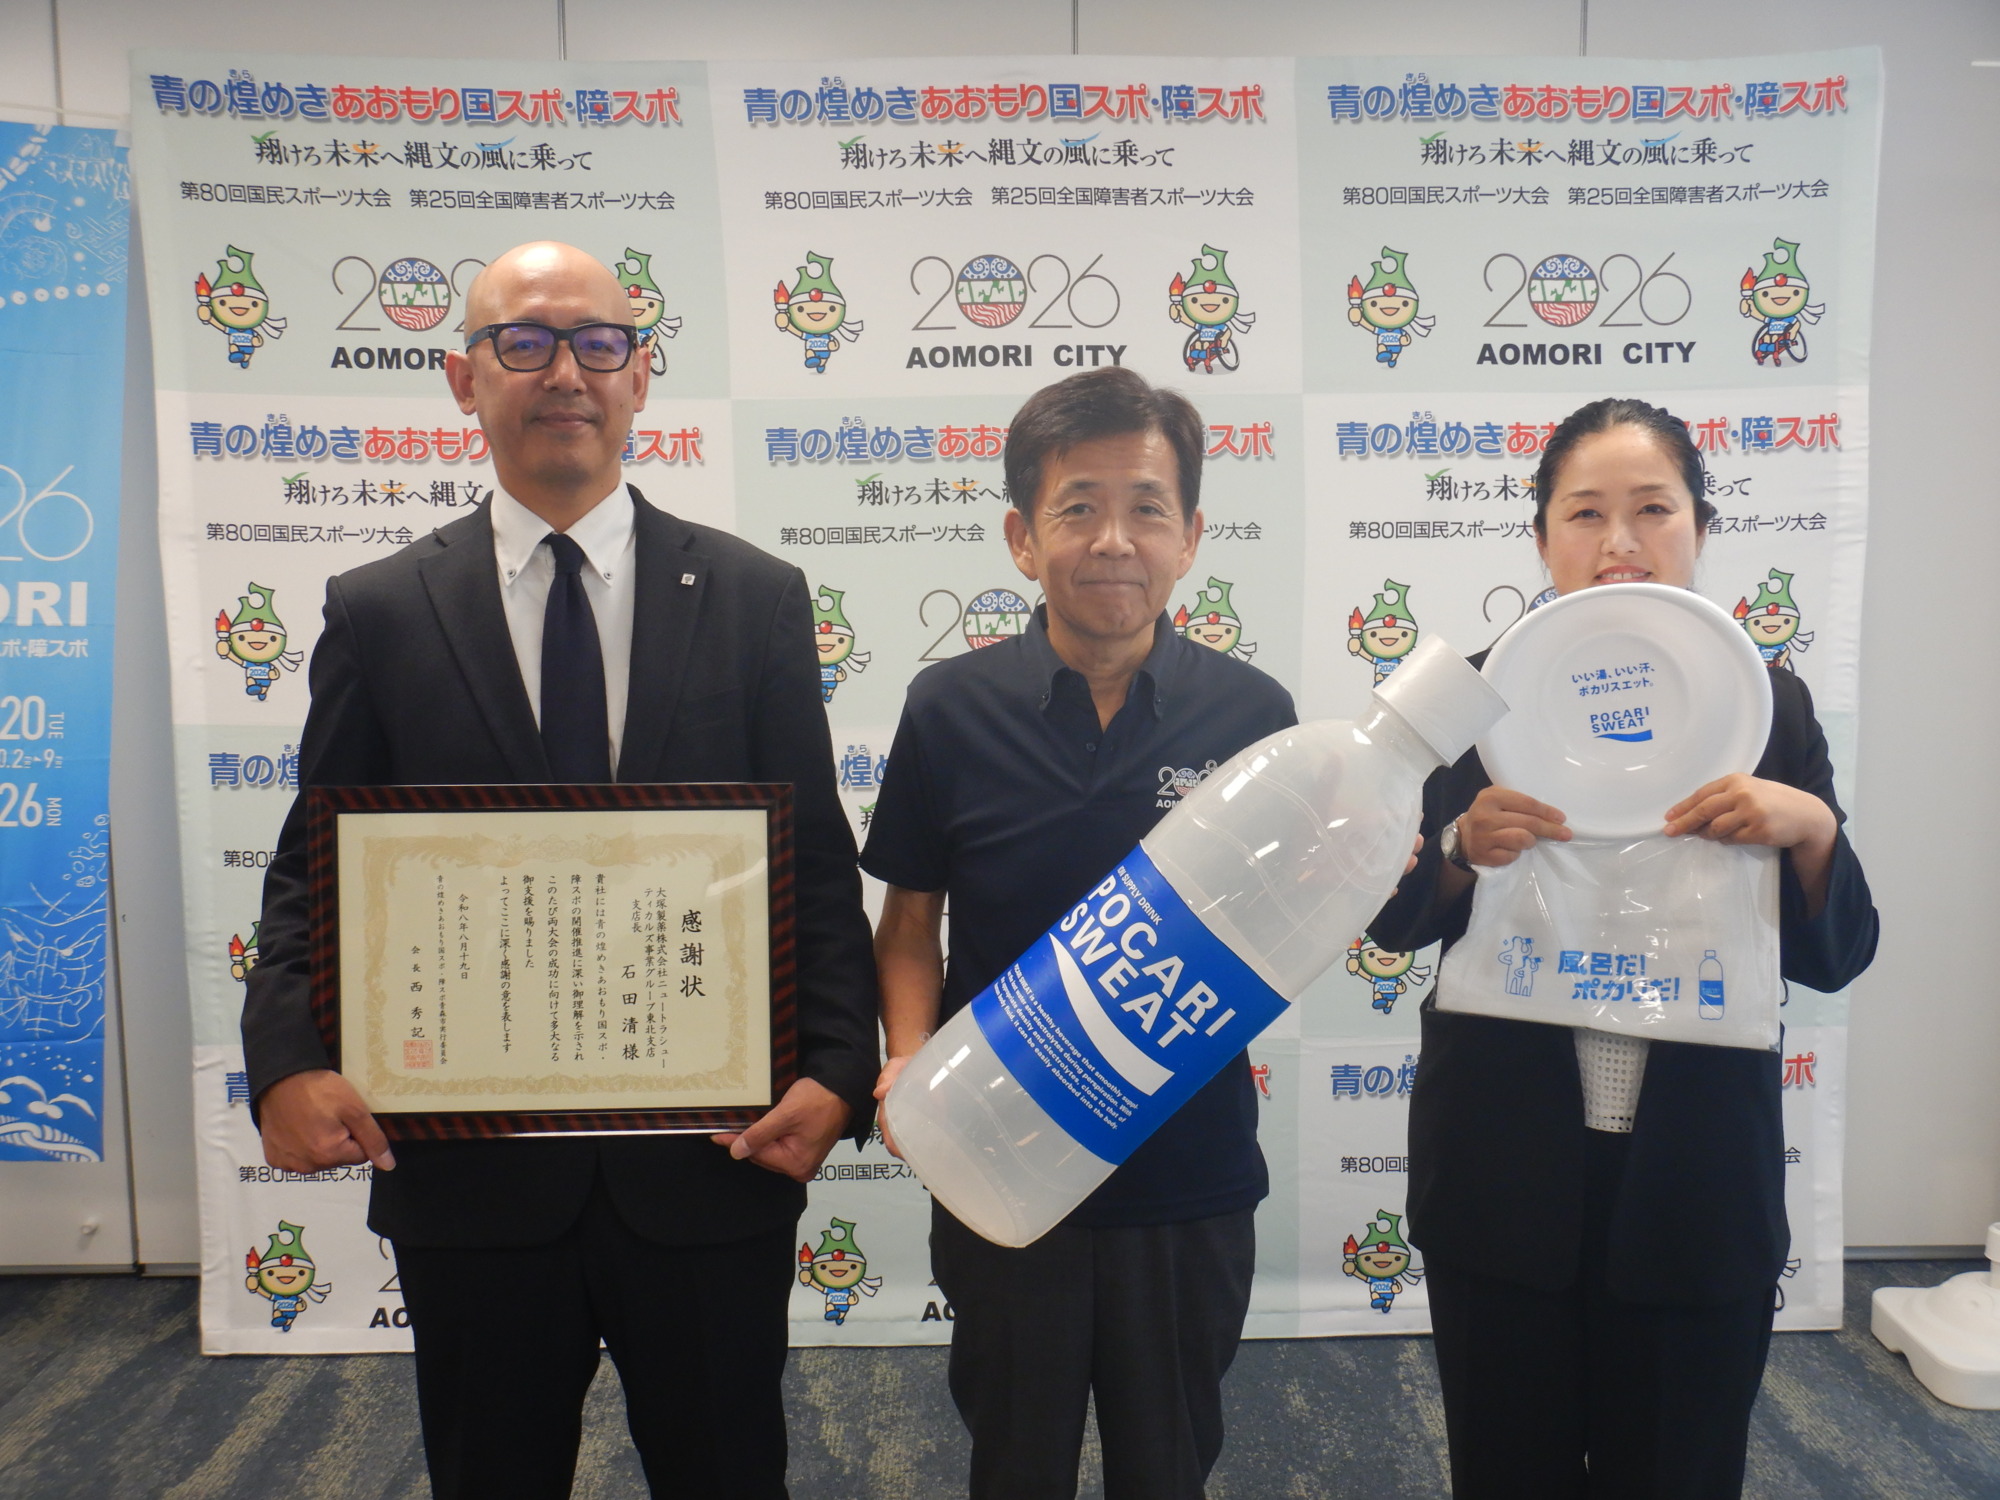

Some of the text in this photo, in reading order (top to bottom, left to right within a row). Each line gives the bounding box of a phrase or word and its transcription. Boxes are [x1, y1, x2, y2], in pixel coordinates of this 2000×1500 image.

[150, 74, 682, 124] 青の煌めきあおもり国スポ・障スポ
[743, 83, 1264, 123] 青の煌めきあおもり国スポ・障スポ
[1327, 75, 1847, 120] 青の煌めきあおもり国スポ・障スポ
[253, 133, 594, 172] 翔けろ未来へ縄文の風に乗って
[840, 136, 1175, 170] 翔けろ未来へ縄文の風に乗って
[1419, 133, 1753, 167] 翔けろ未来へ縄文の風に乗って
[180, 181, 675, 211] 第80回国民スポーツ大会 第25回全国障害者スポーツ大会
[764, 185, 1254, 210] 第80回国民スポーツ大会 第25回全国障害者スポーツ大会
[1343, 178, 1829, 206] 第80回国民スポーツ大会 第25回全国障害者スポーツ大会
[232, 335, 252, 345] 2026
[808, 339, 827, 349] 2026
[1380, 334, 1399, 343] 2026
[1476, 341, 1696, 366] AOMORI CITY
[906, 344, 1127, 369] AOMORI CITY
[765, 425, 1008, 461] 青の煌めきあお
[206, 523, 413, 545] 第80回国民スポーツ大会
[780, 525, 985, 546] 第80回国民スポーツ大会
[1349, 521, 1537, 540] 第80回国民スポーツ大
[0, 581, 88, 626] RI
[0, 639, 88, 658] ポ・障スポ
[48, 712, 64, 739] TUE
[1590, 706, 1649, 724] POCARI
[1591, 717, 1645, 733] SWEAT
[44, 749, 55, 768] 9
[0, 782, 62, 828] 26 MON
[632, 899, 642, 933] 支店長
[1121, 873, 1142, 899] SUPPLY
[1137, 896, 1162, 925] DRINK
[523, 875, 535, 969] 御支援を賜りました
[548, 875, 560, 1061] このたび両大会の成功に向けて多大なる
[680, 909, 705, 997] 感謝状
[1088, 874, 1236, 1036] POCARI
[1060, 902, 1196, 1048] SWEAT
[1377, 983, 1395, 992] 2026
[1015, 989, 1027, 1005] water
[1024, 1004, 1036, 1016] and
[1033, 1016, 1064, 1052] electrolytes
[1063, 1052, 1083, 1074] during
[1029, 993, 1035, 1001] is
[1037, 1004, 1056, 1028] healthy
[1055, 1027, 1081, 1058] beverage
[1082, 1058, 1095, 1071] that
[1095, 1072, 1121, 1097] smoothly
[1016, 1008, 1034, 1031] density
[1033, 1031, 1045, 1044] and
[1081, 1085, 1098, 1100] close
[1106, 1107, 1118, 1117] that
[1018, 1027, 1028, 1039] can
[1027, 1037, 1035, 1048] be
[1034, 1048, 1052, 1067] easily
[1051, 1068, 1081, 1096] absorbed
[1080, 1097, 1093, 1108] into
[1093, 1108, 1103, 1117] the
[1373, 1283, 1391, 1292] 2026
